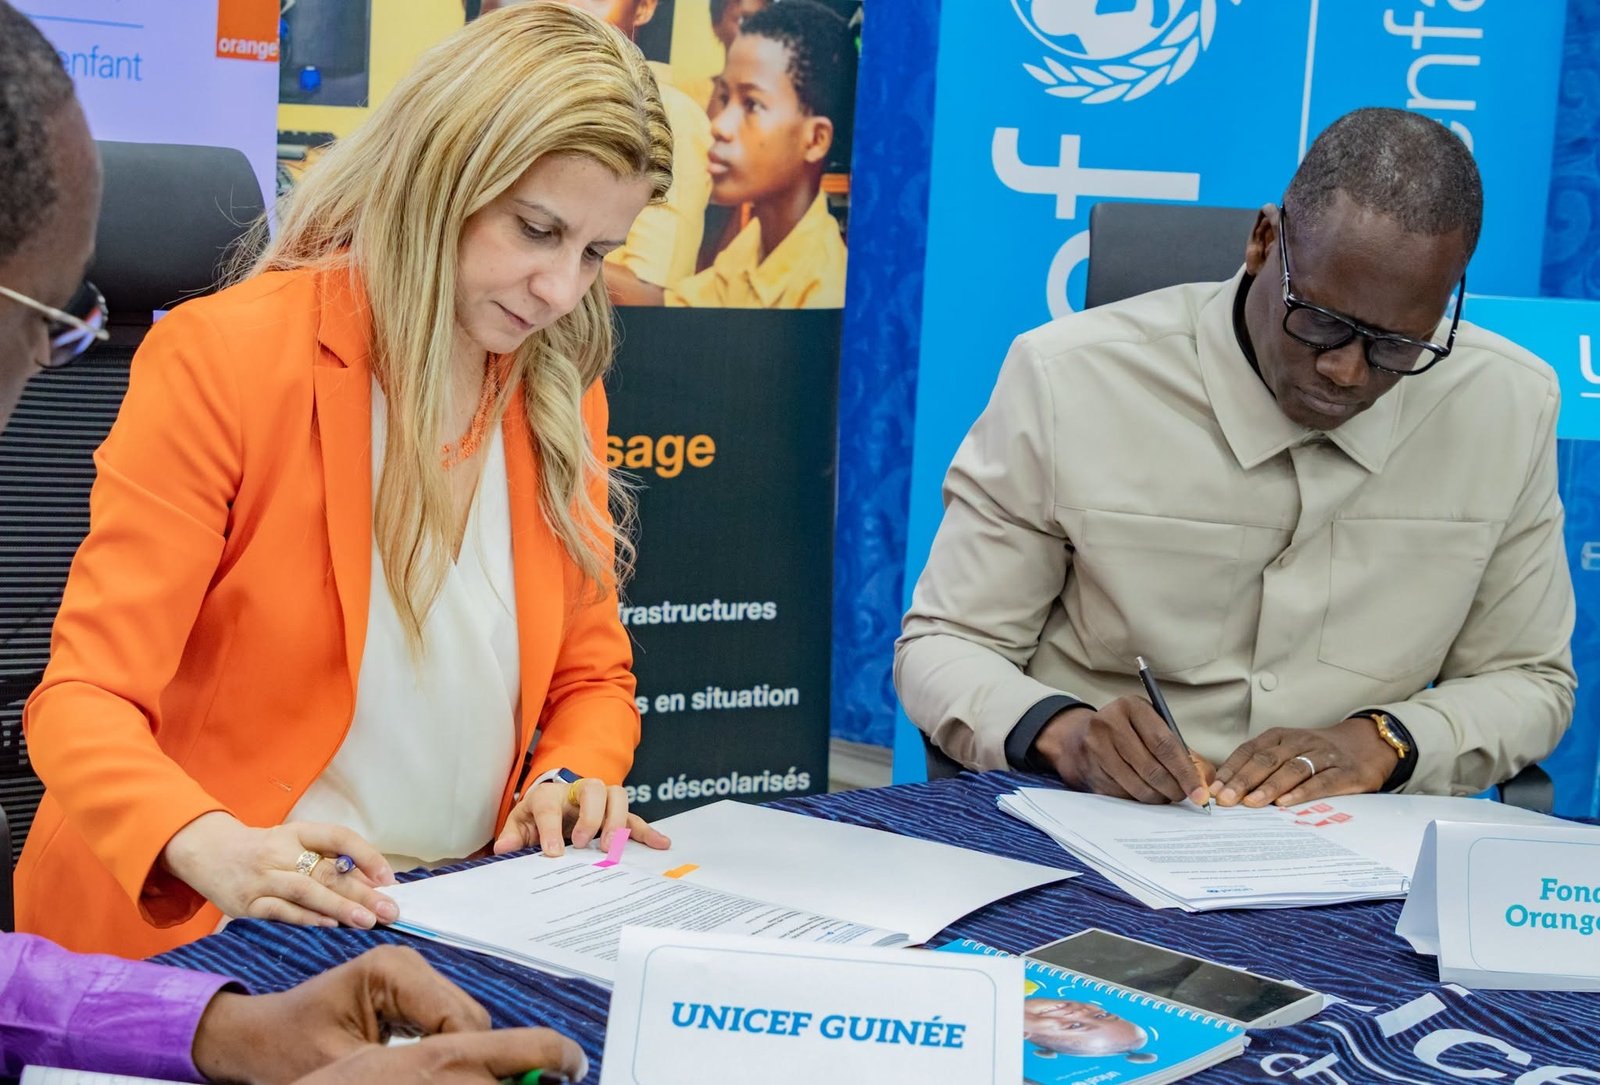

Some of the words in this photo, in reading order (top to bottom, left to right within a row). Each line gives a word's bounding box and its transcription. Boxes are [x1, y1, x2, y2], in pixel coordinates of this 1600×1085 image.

[218, 37, 278, 60] orange
[607, 434, 716, 478] sage
[655, 693, 685, 713] en
[691, 684, 799, 710] situation
[657, 766, 810, 801] déscolarisés
[672, 1002, 811, 1036] UNICEF
[819, 1015, 967, 1049] GUINÉE
